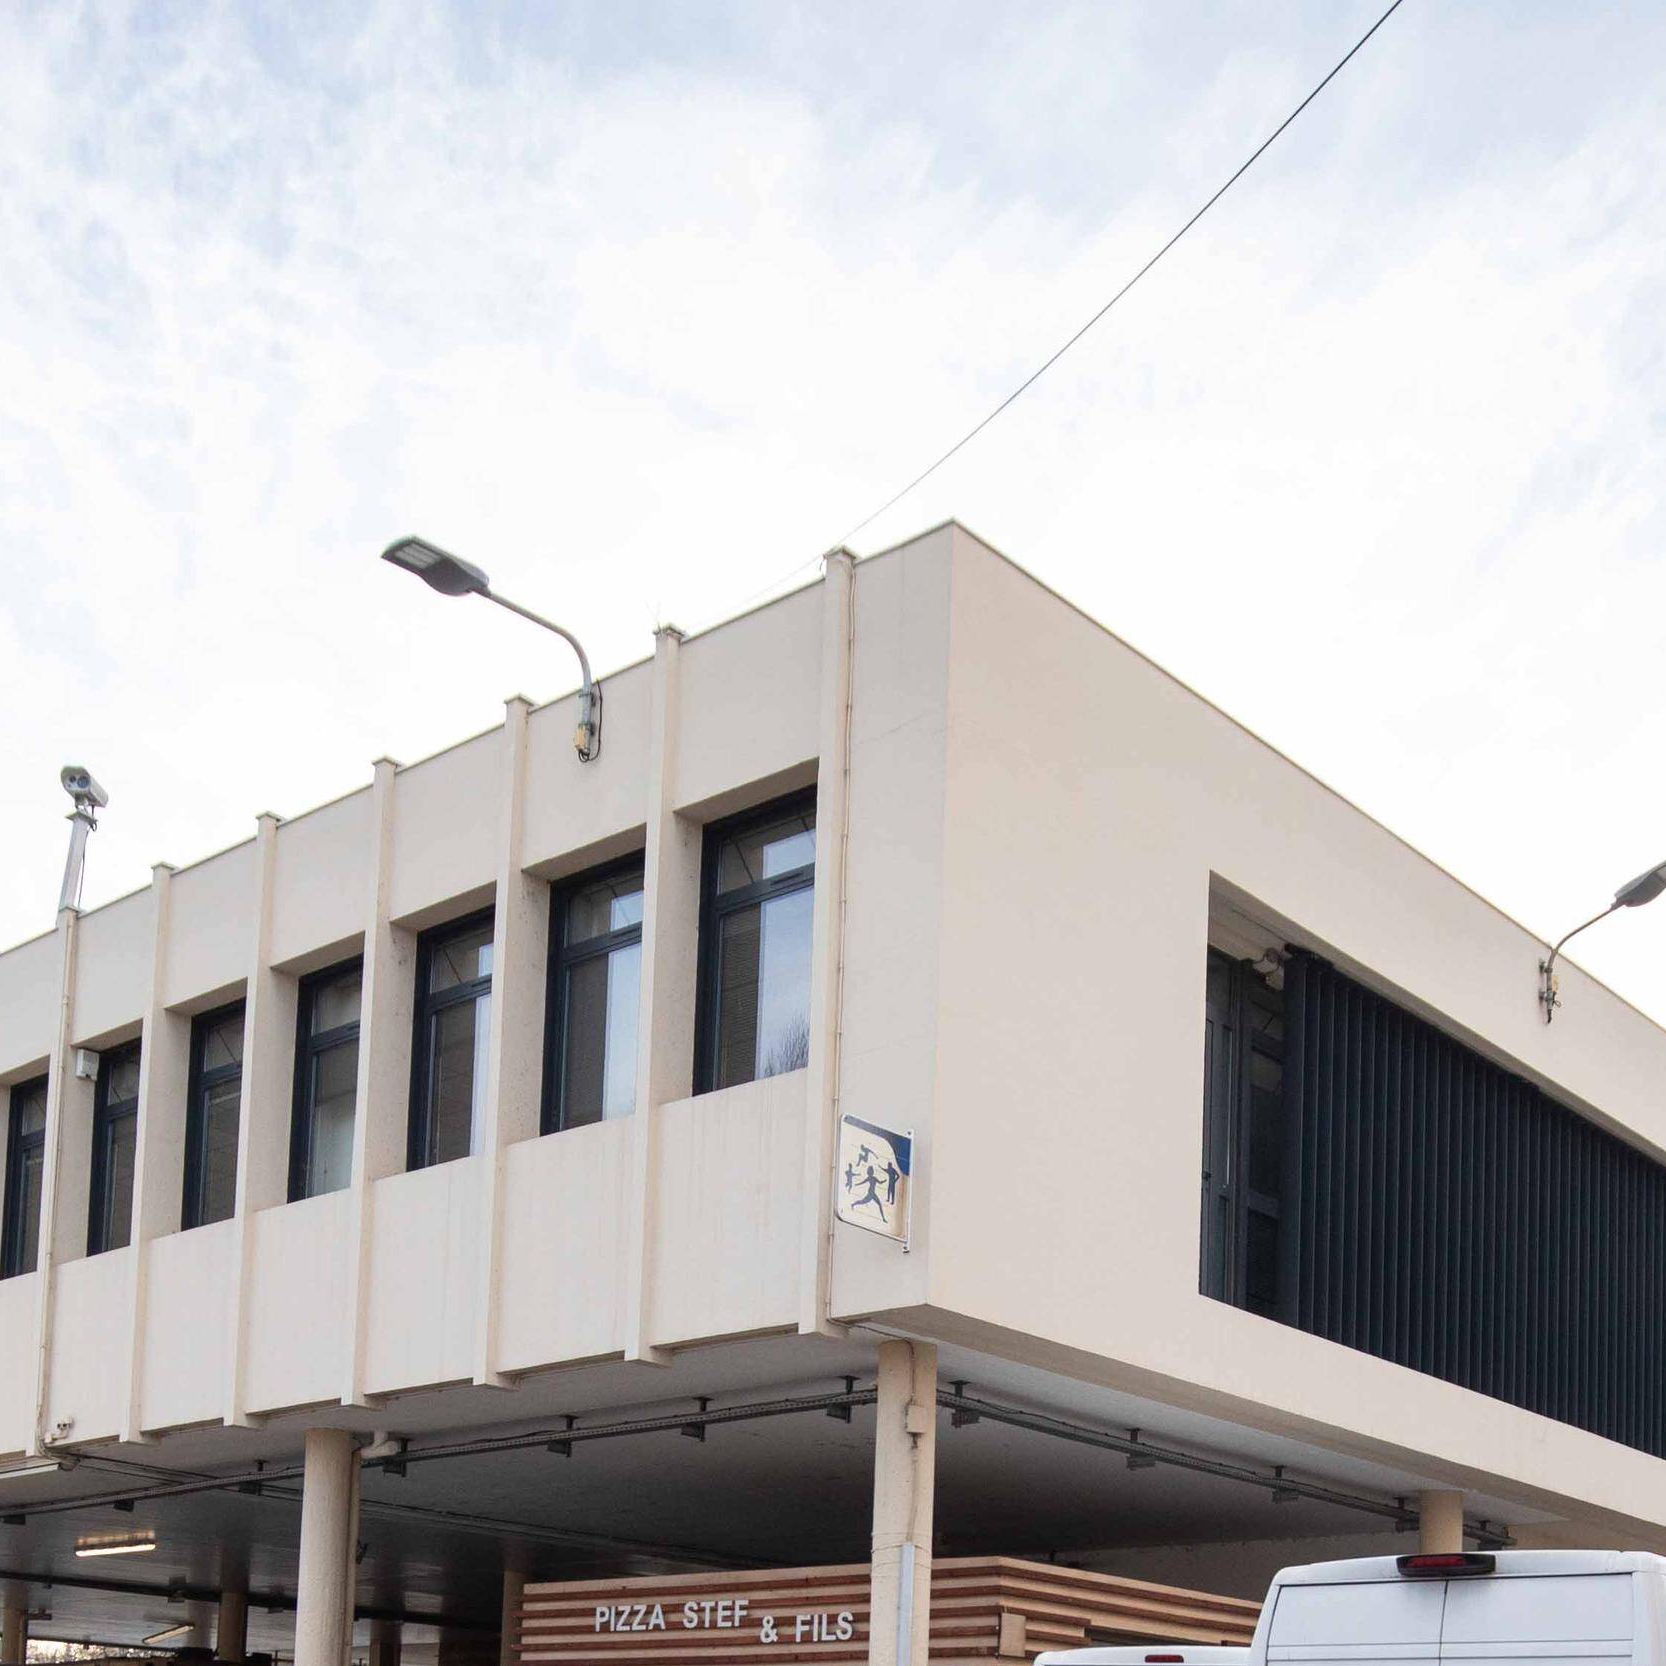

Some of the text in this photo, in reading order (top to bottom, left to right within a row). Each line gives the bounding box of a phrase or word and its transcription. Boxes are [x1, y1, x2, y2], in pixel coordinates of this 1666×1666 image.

[594, 1599, 854, 1643] PIZZA STEF & FILS
